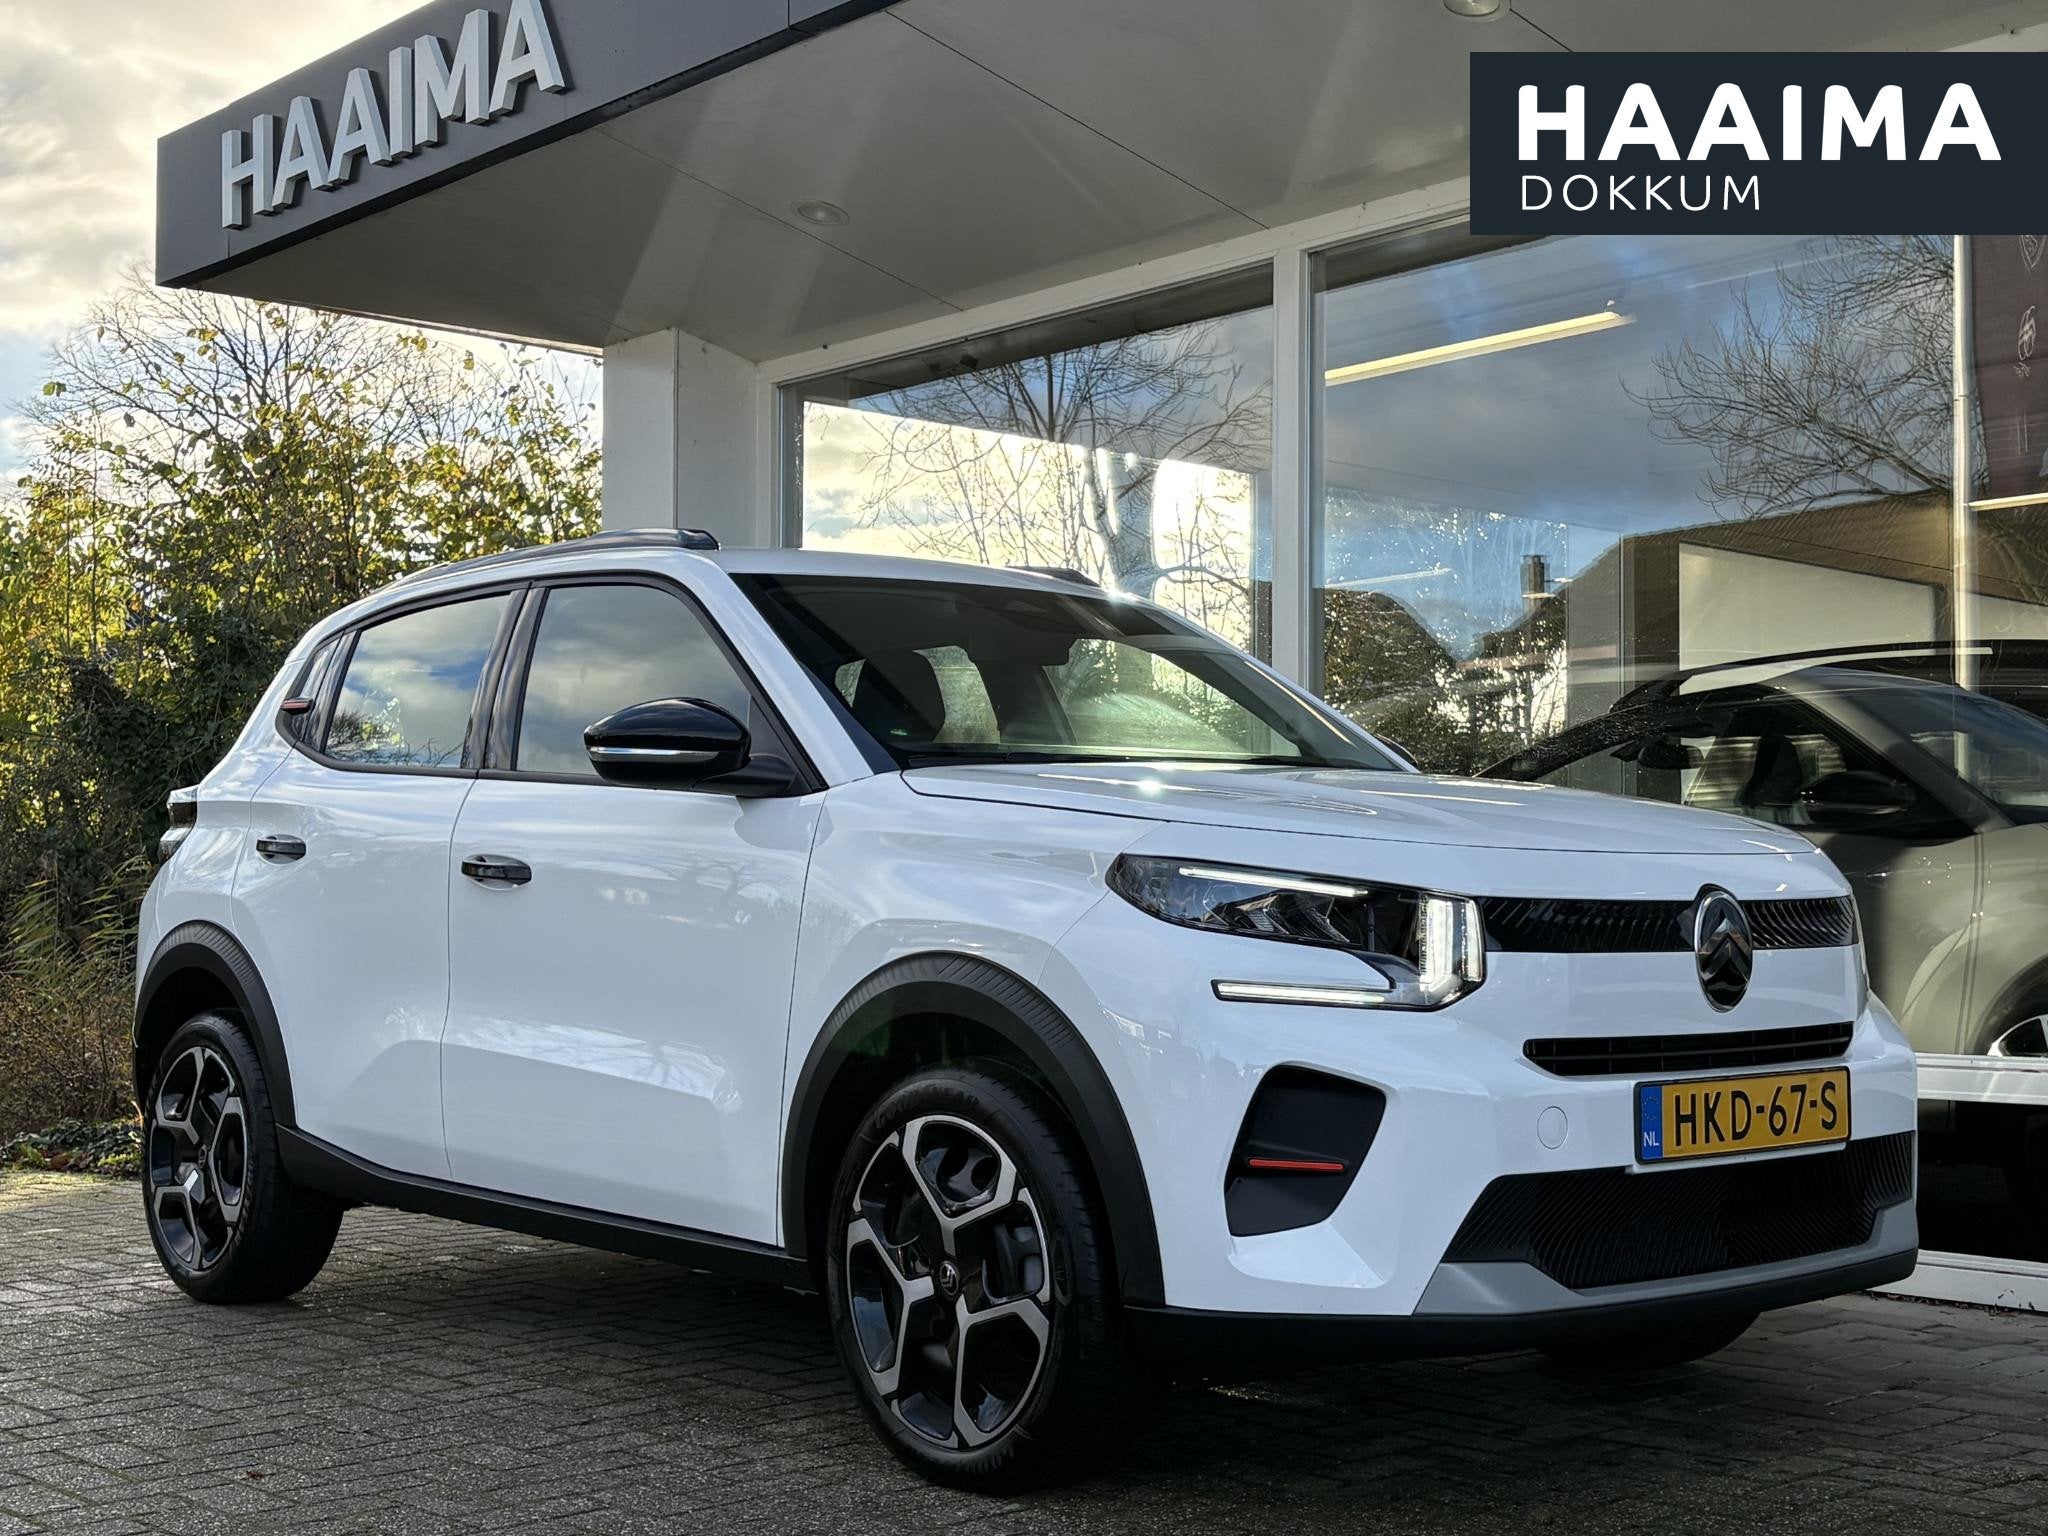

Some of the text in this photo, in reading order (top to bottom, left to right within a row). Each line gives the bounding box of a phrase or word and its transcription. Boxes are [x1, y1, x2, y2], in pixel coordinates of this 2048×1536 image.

[221, 0, 566, 230] HAAIMA
[1643, 1131, 1660, 1148] NL
[1674, 1080, 1837, 1147] HKD-67-S
